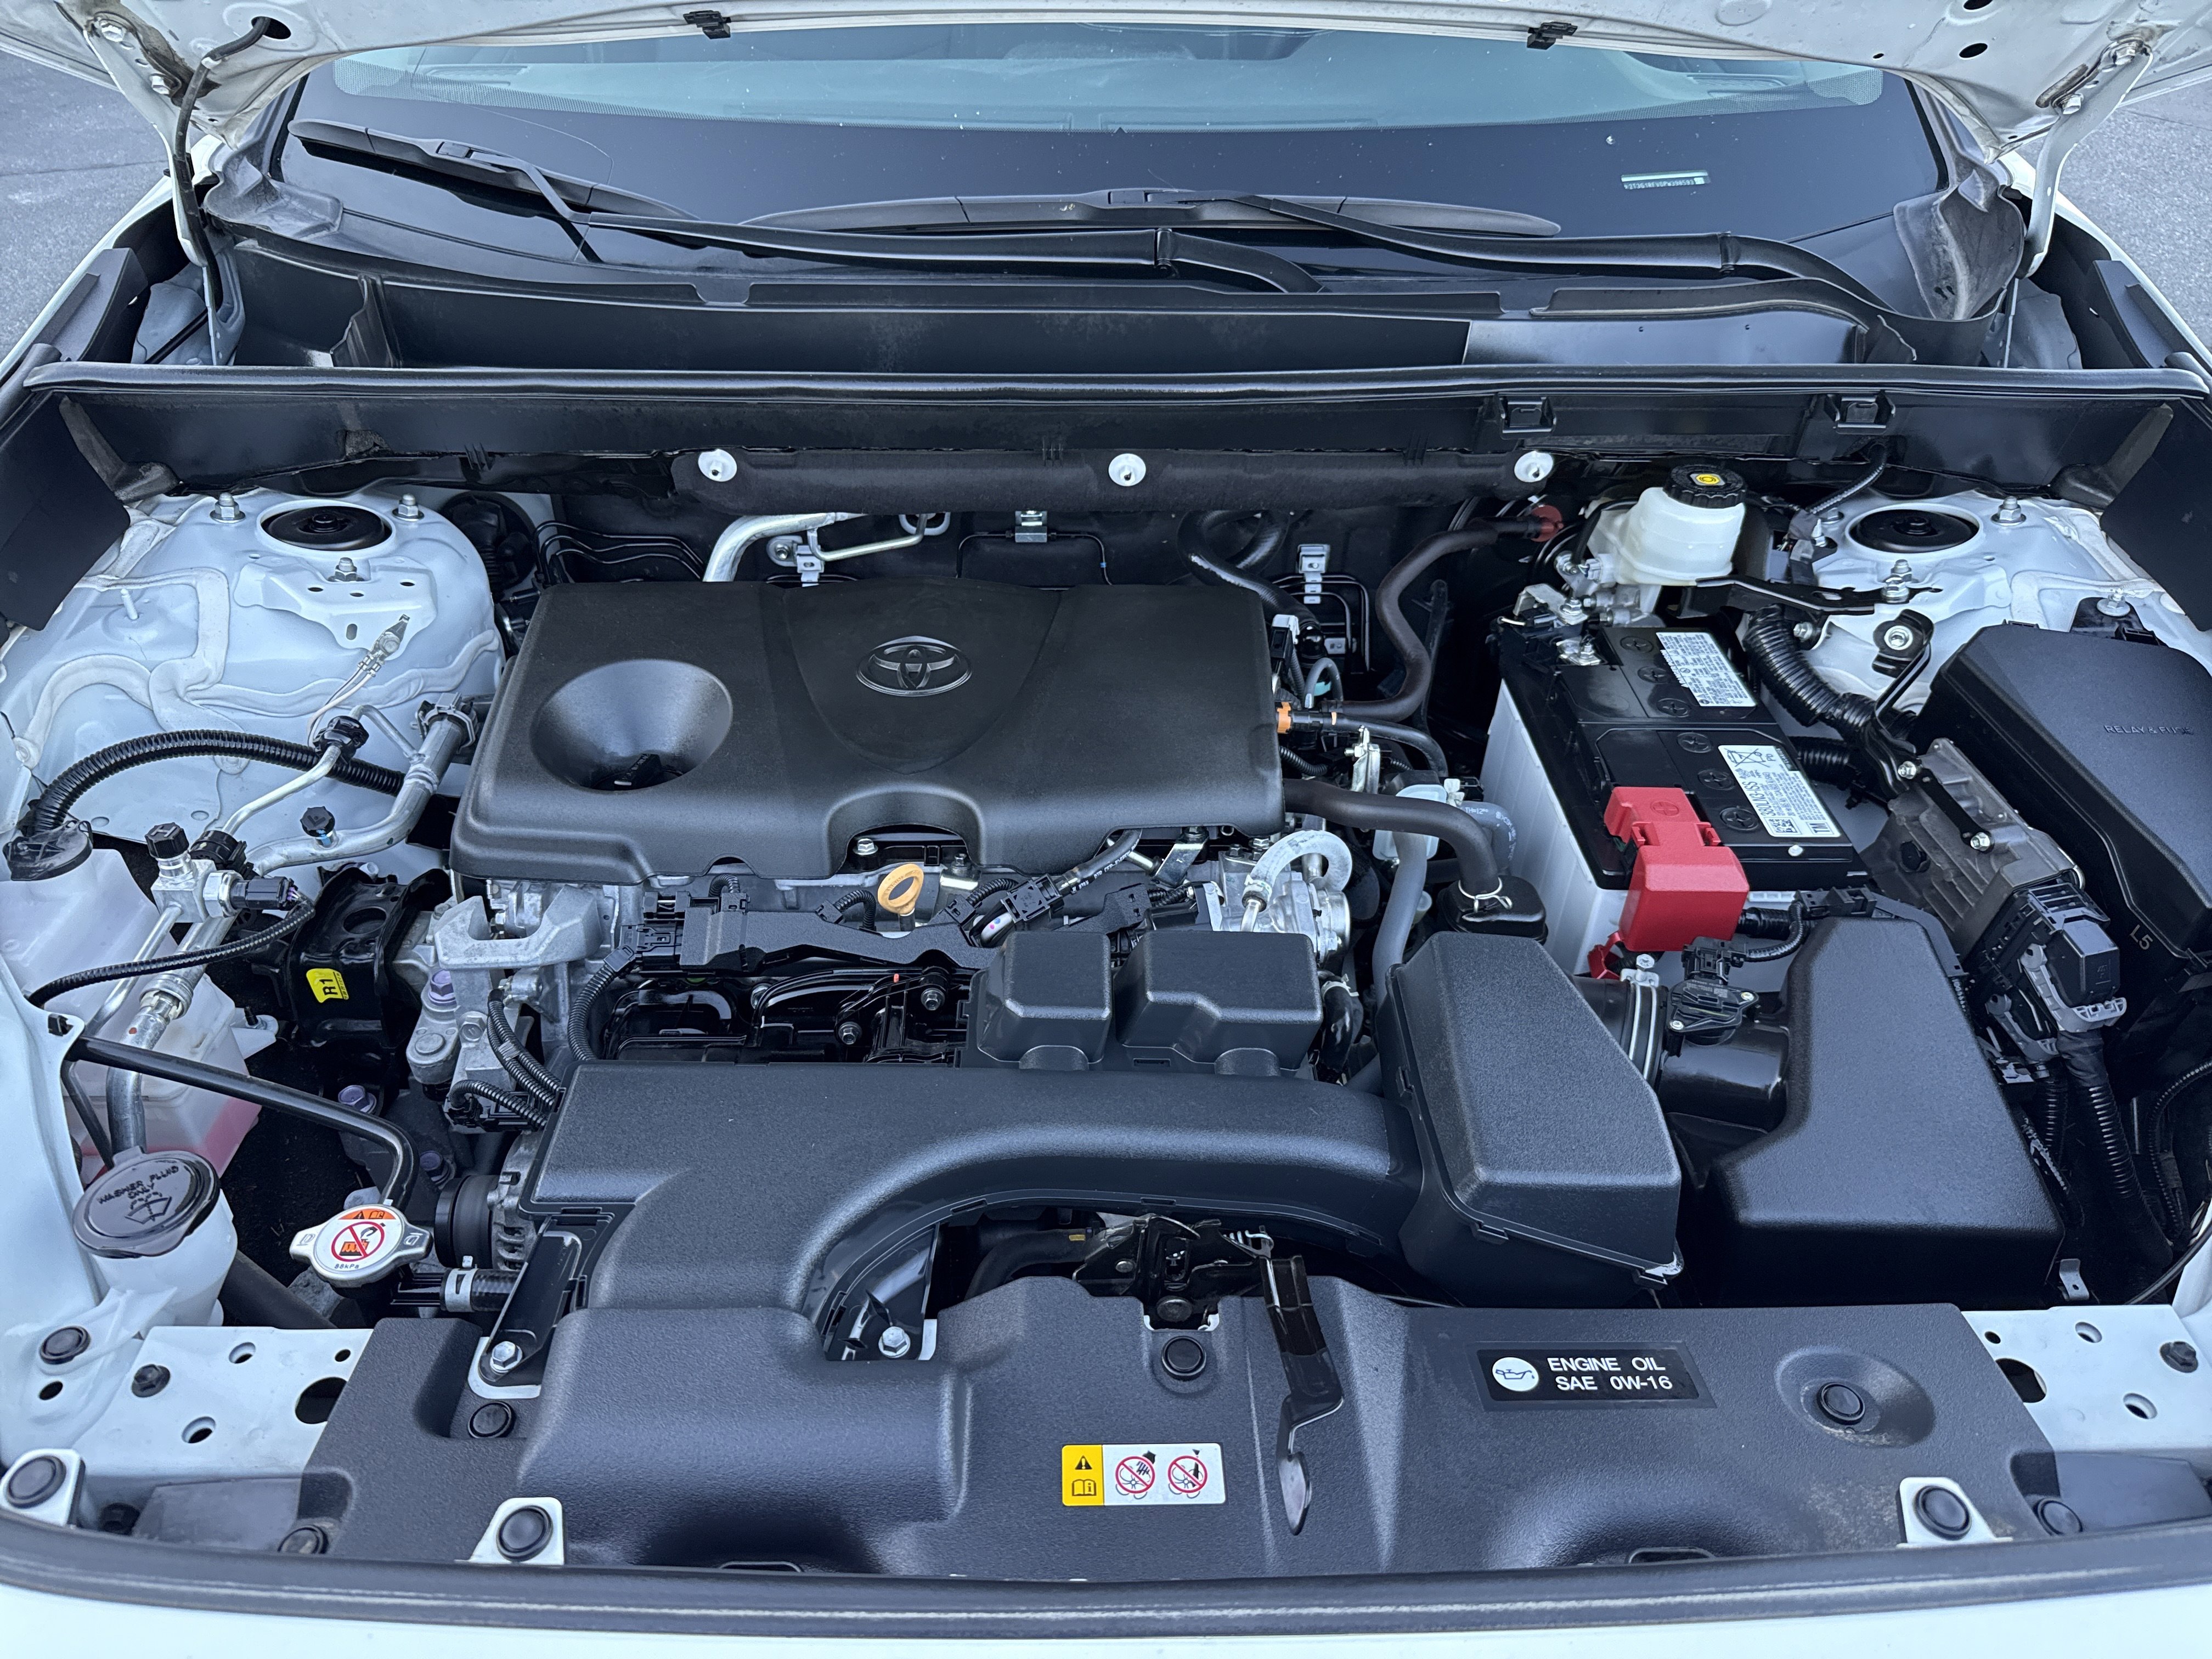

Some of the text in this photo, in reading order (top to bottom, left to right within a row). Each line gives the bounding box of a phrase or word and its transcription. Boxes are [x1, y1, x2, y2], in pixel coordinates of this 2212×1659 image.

[2104, 725, 2145, 733] RELAY
[1765, 753, 1776, 762] Pb
[1741, 781, 1776, 816] 380LN3-ISS
[151, 825, 177, 838] H
[1810, 823, 1830, 833] TM
[2130, 924, 2153, 950] L5
[319, 979, 338, 995] R1
[97, 1166, 179, 1204] WASHER FLUID
[127, 1182, 155, 1200] ONLY
[1547, 1357, 1666, 1372] ENGINE OIL
[1555, 1375, 1673, 1391] SAE 0W-16
